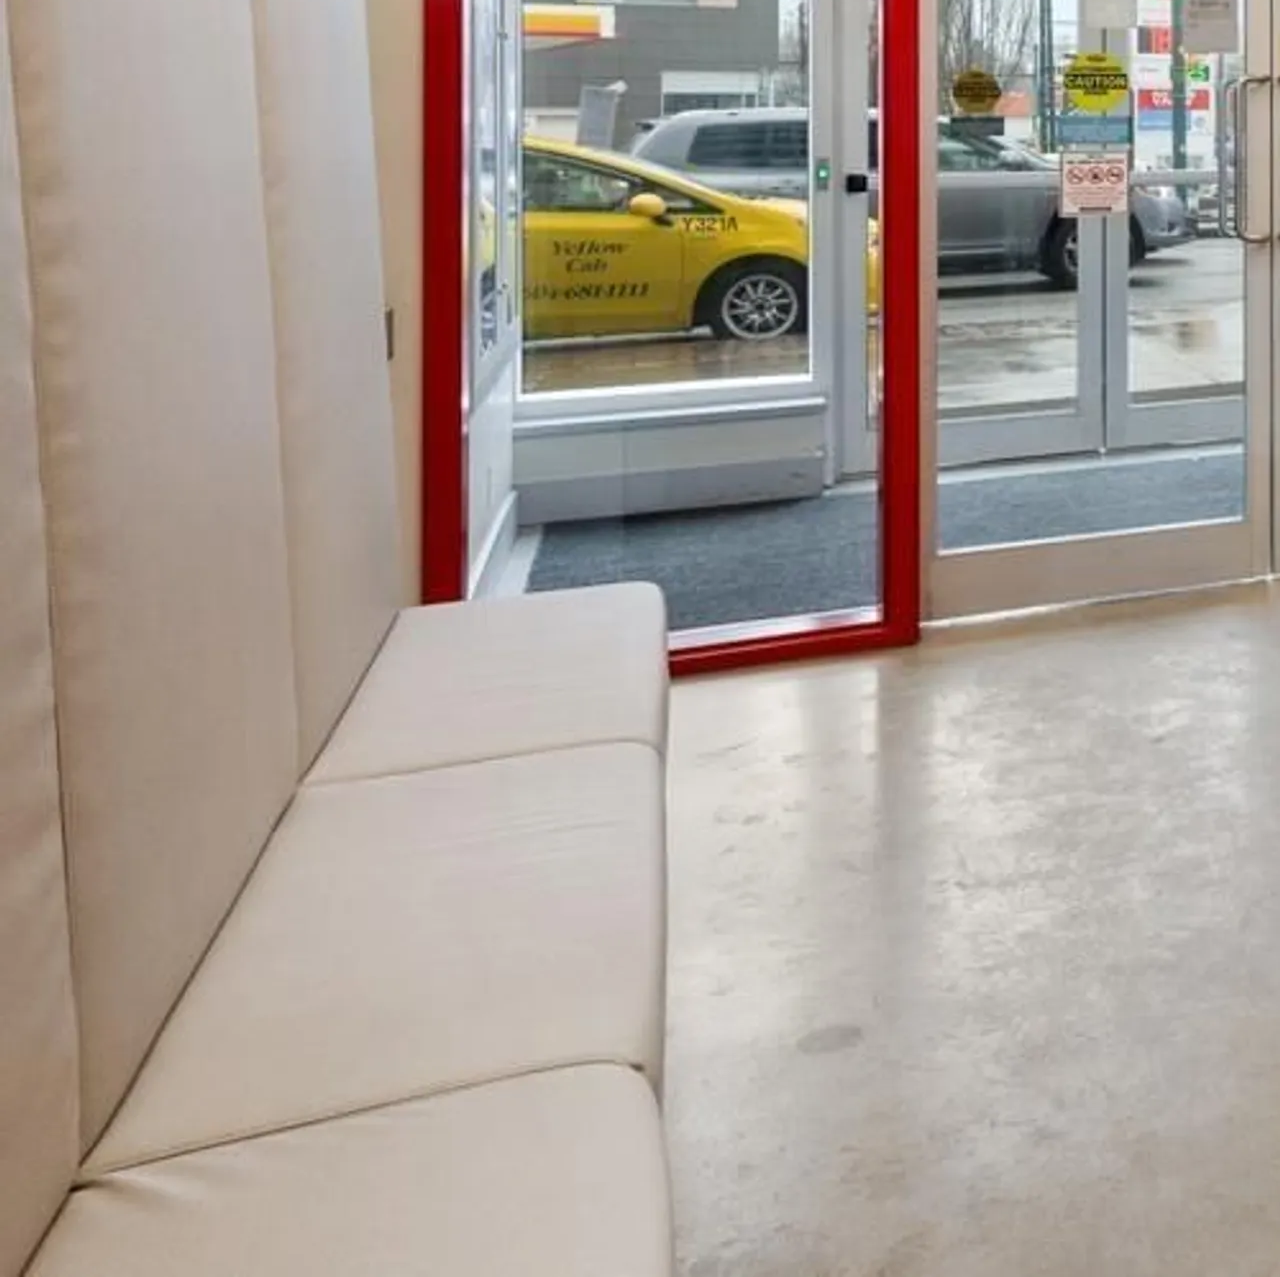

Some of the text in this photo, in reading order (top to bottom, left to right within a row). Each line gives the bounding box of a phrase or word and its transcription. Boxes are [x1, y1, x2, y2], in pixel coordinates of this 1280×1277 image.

[1064, 75, 1128, 89] CAUTION
[552, 240, 630, 256] Yellow
[565, 258, 608, 273] Cab
